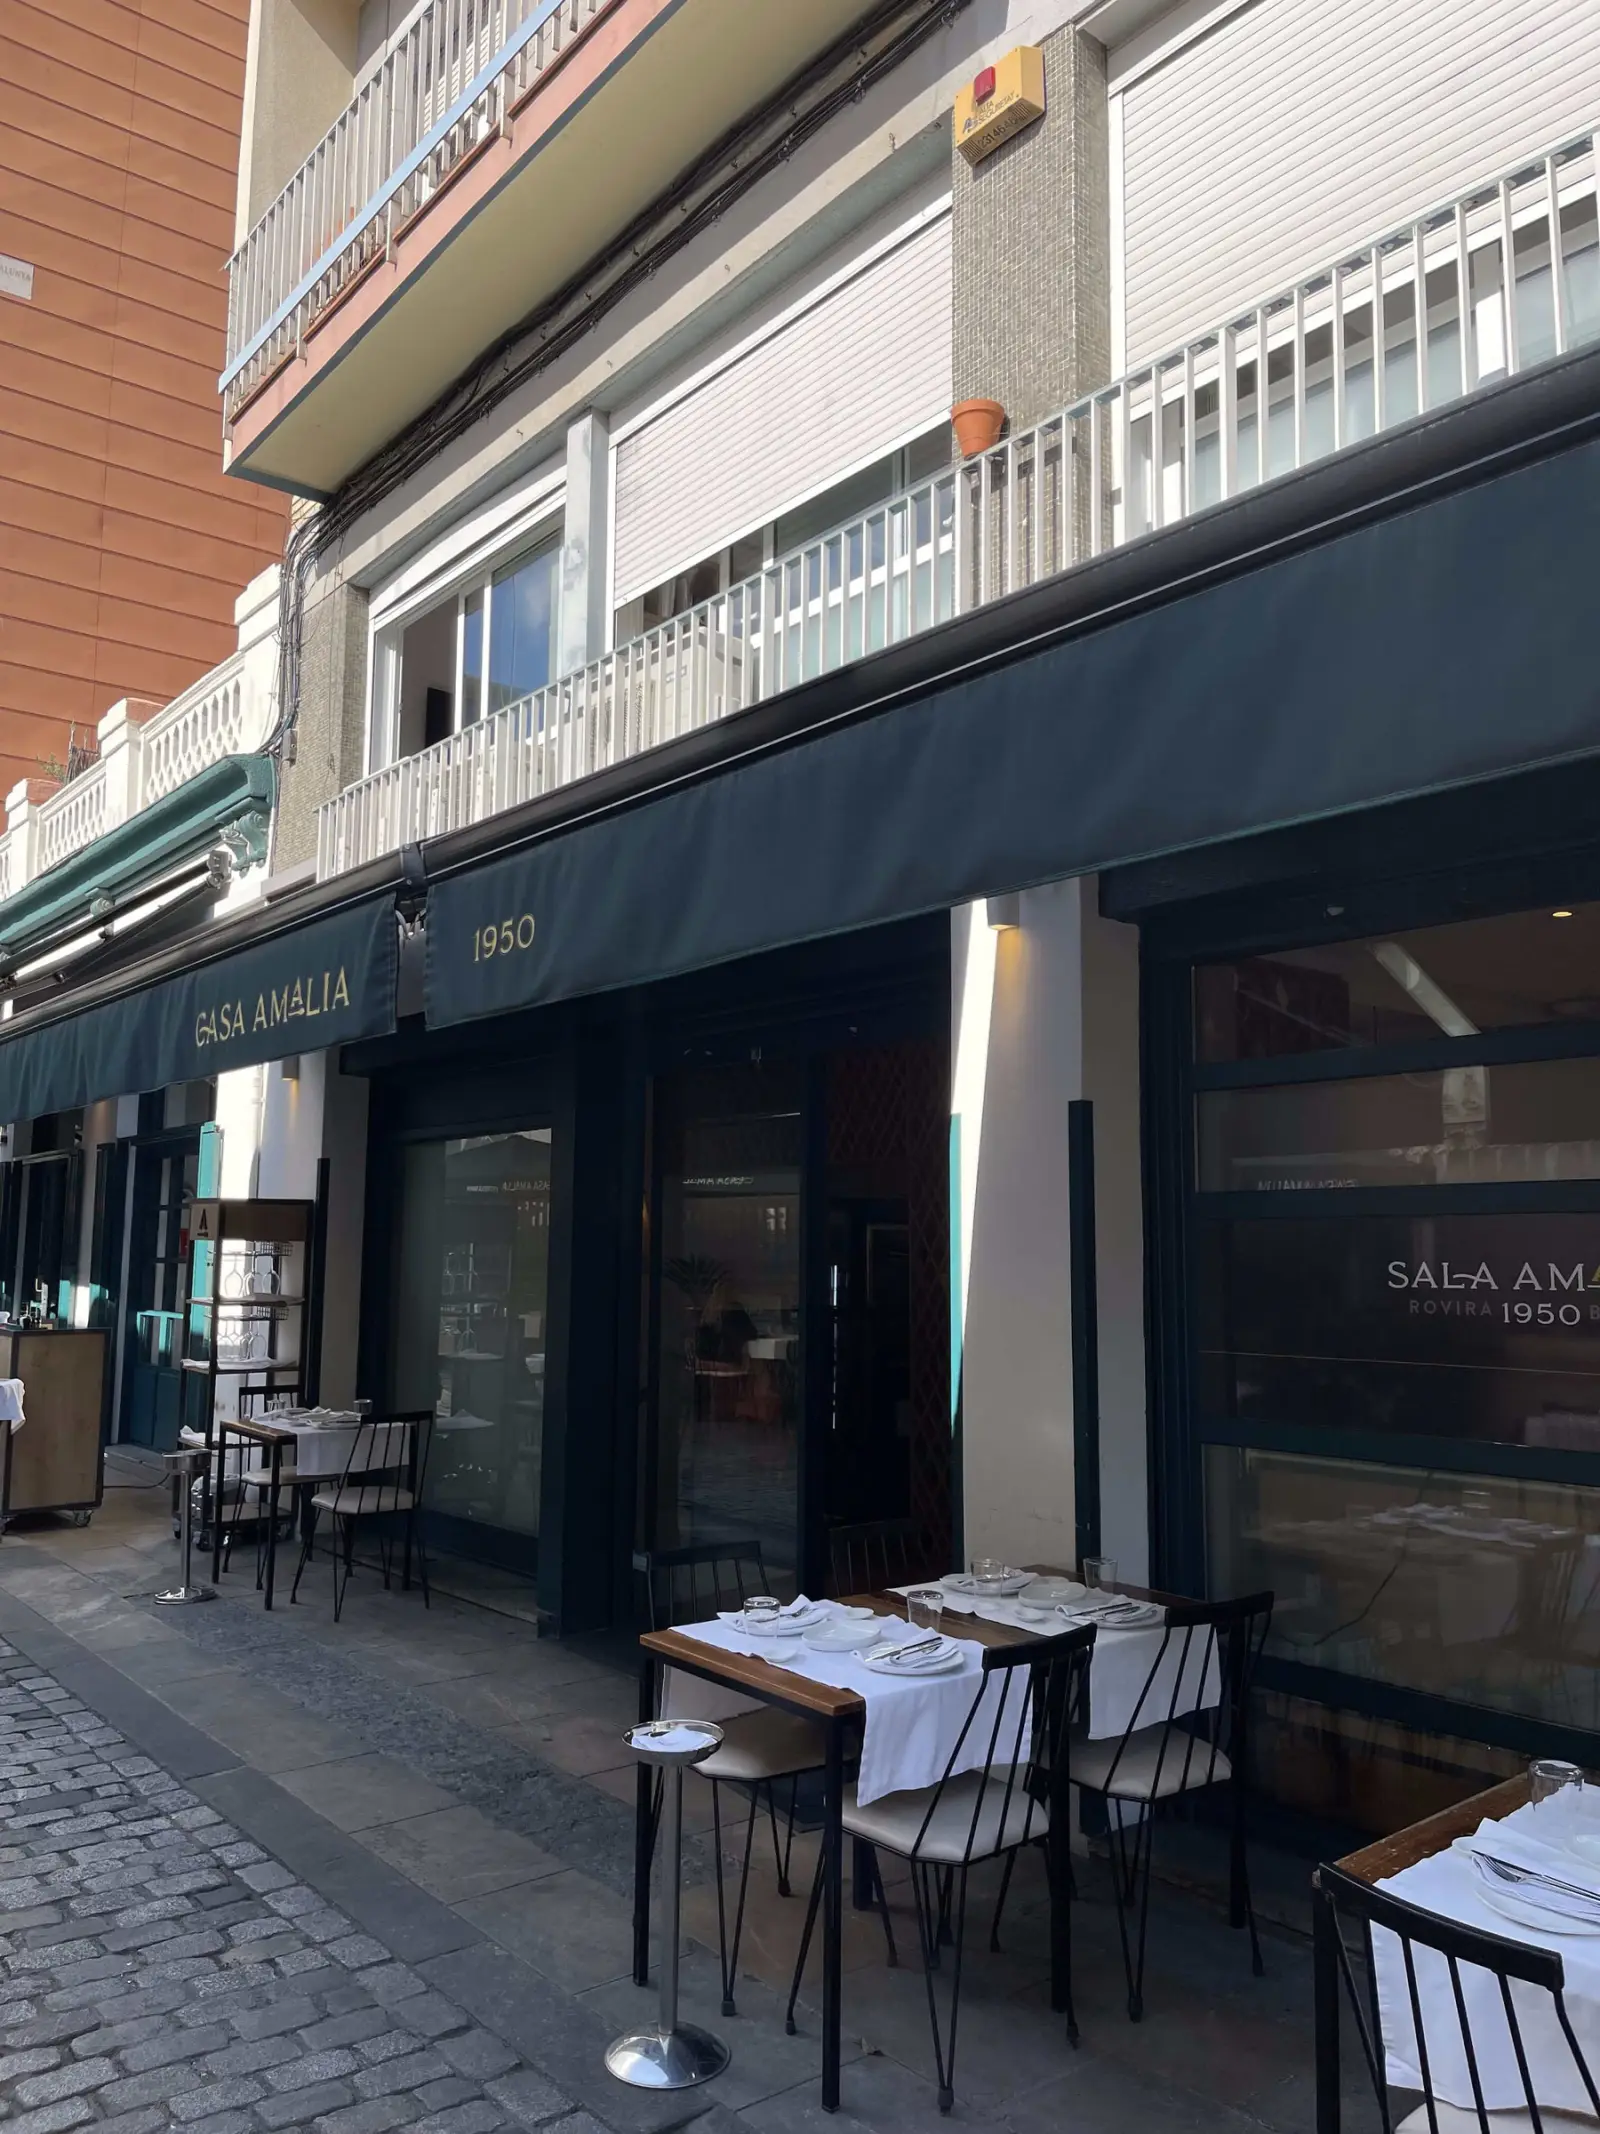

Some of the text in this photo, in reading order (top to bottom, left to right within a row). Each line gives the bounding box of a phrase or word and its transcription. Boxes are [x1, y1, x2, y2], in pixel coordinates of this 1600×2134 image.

[471, 914, 535, 962] 1950
[196, 965, 350, 1047] CASA AMALIA
[1388, 1261, 1499, 1290] SALA
[1409, 1300, 1492, 1316] ROVIRA
[1502, 1302, 1581, 1325] 1950
